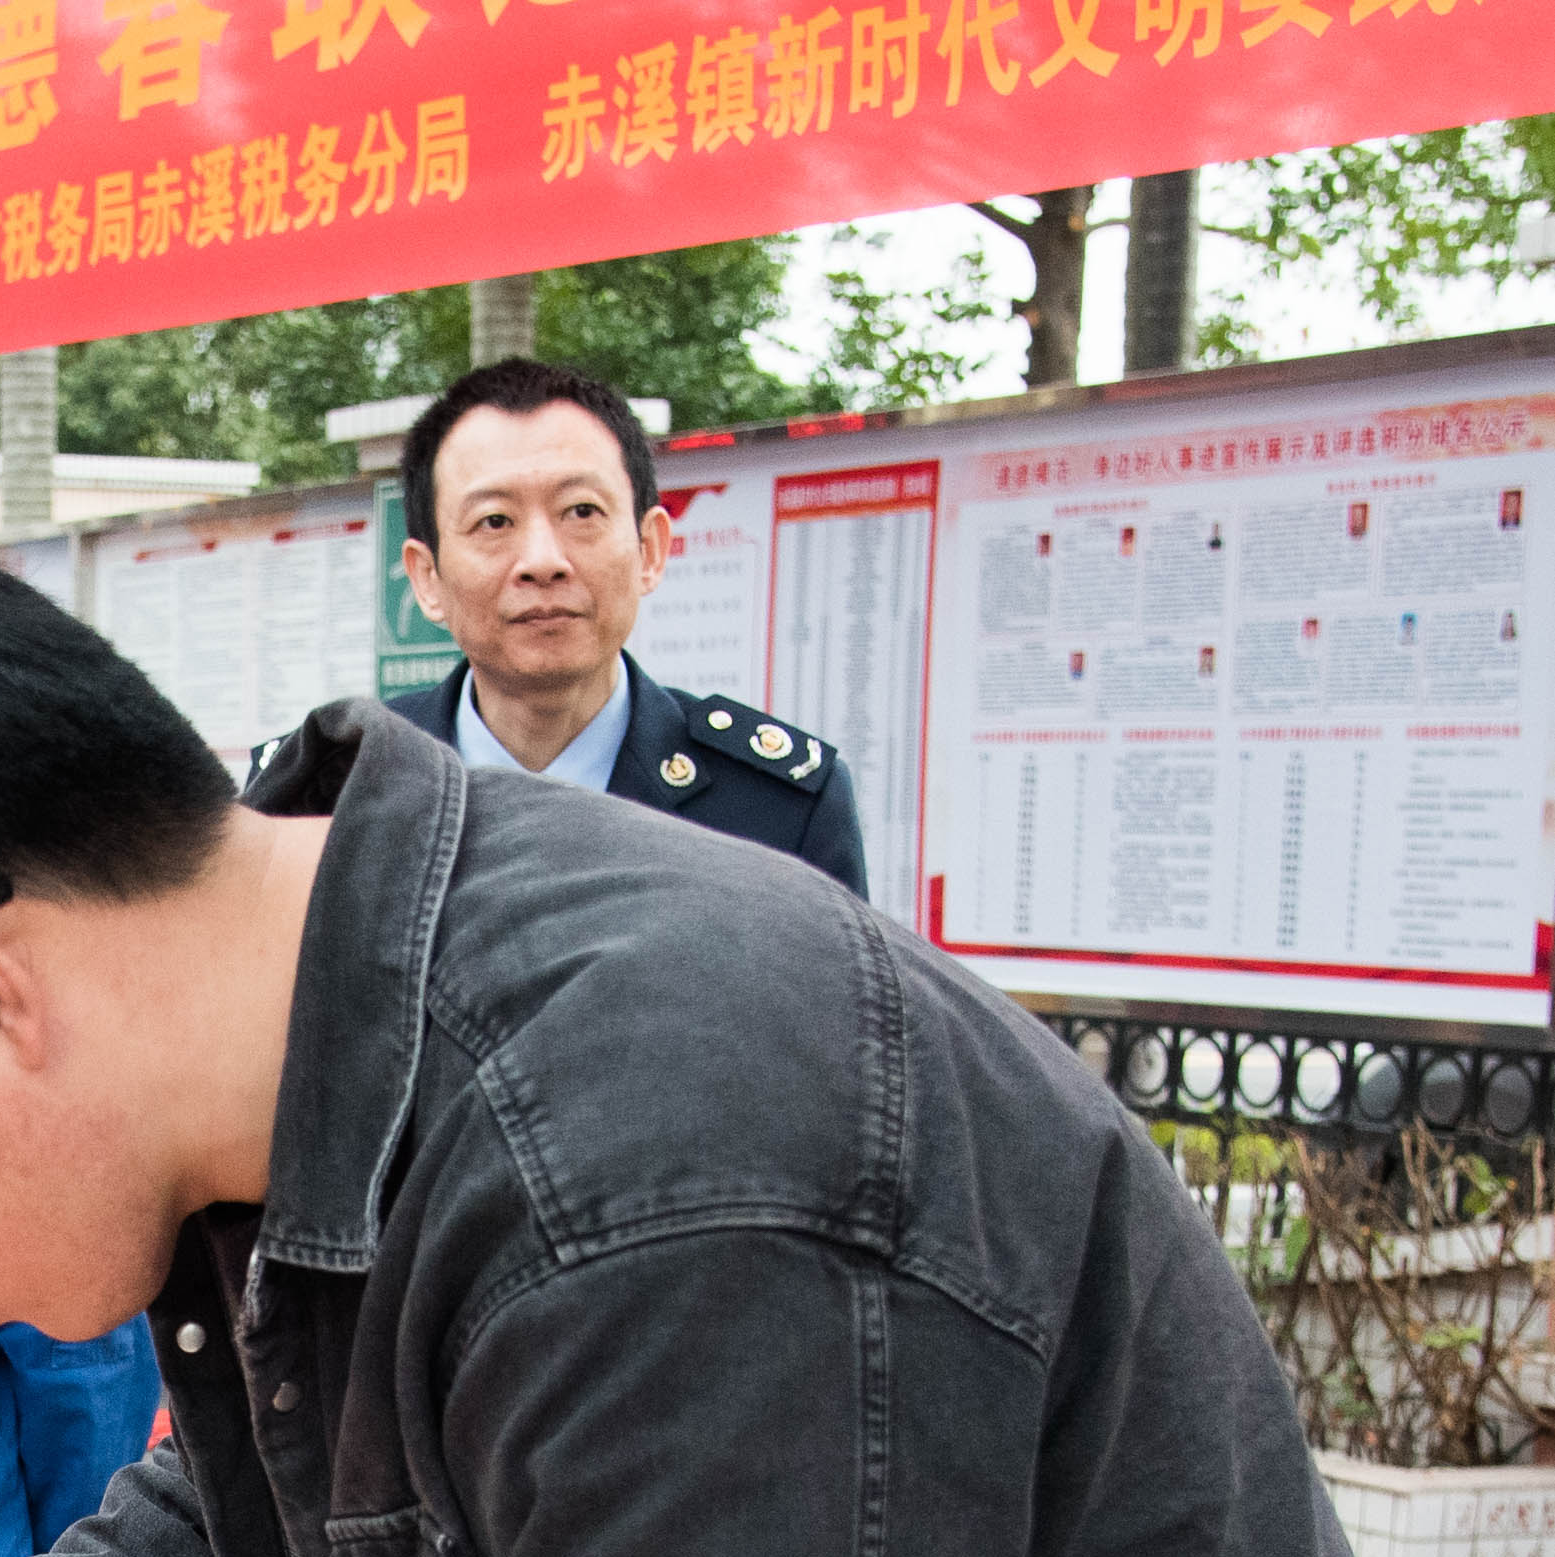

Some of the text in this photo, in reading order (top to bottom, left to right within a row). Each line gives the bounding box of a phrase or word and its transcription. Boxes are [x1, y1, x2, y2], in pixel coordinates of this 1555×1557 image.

[540, 0, 1485, 183] 赤溪镇新时代文明
